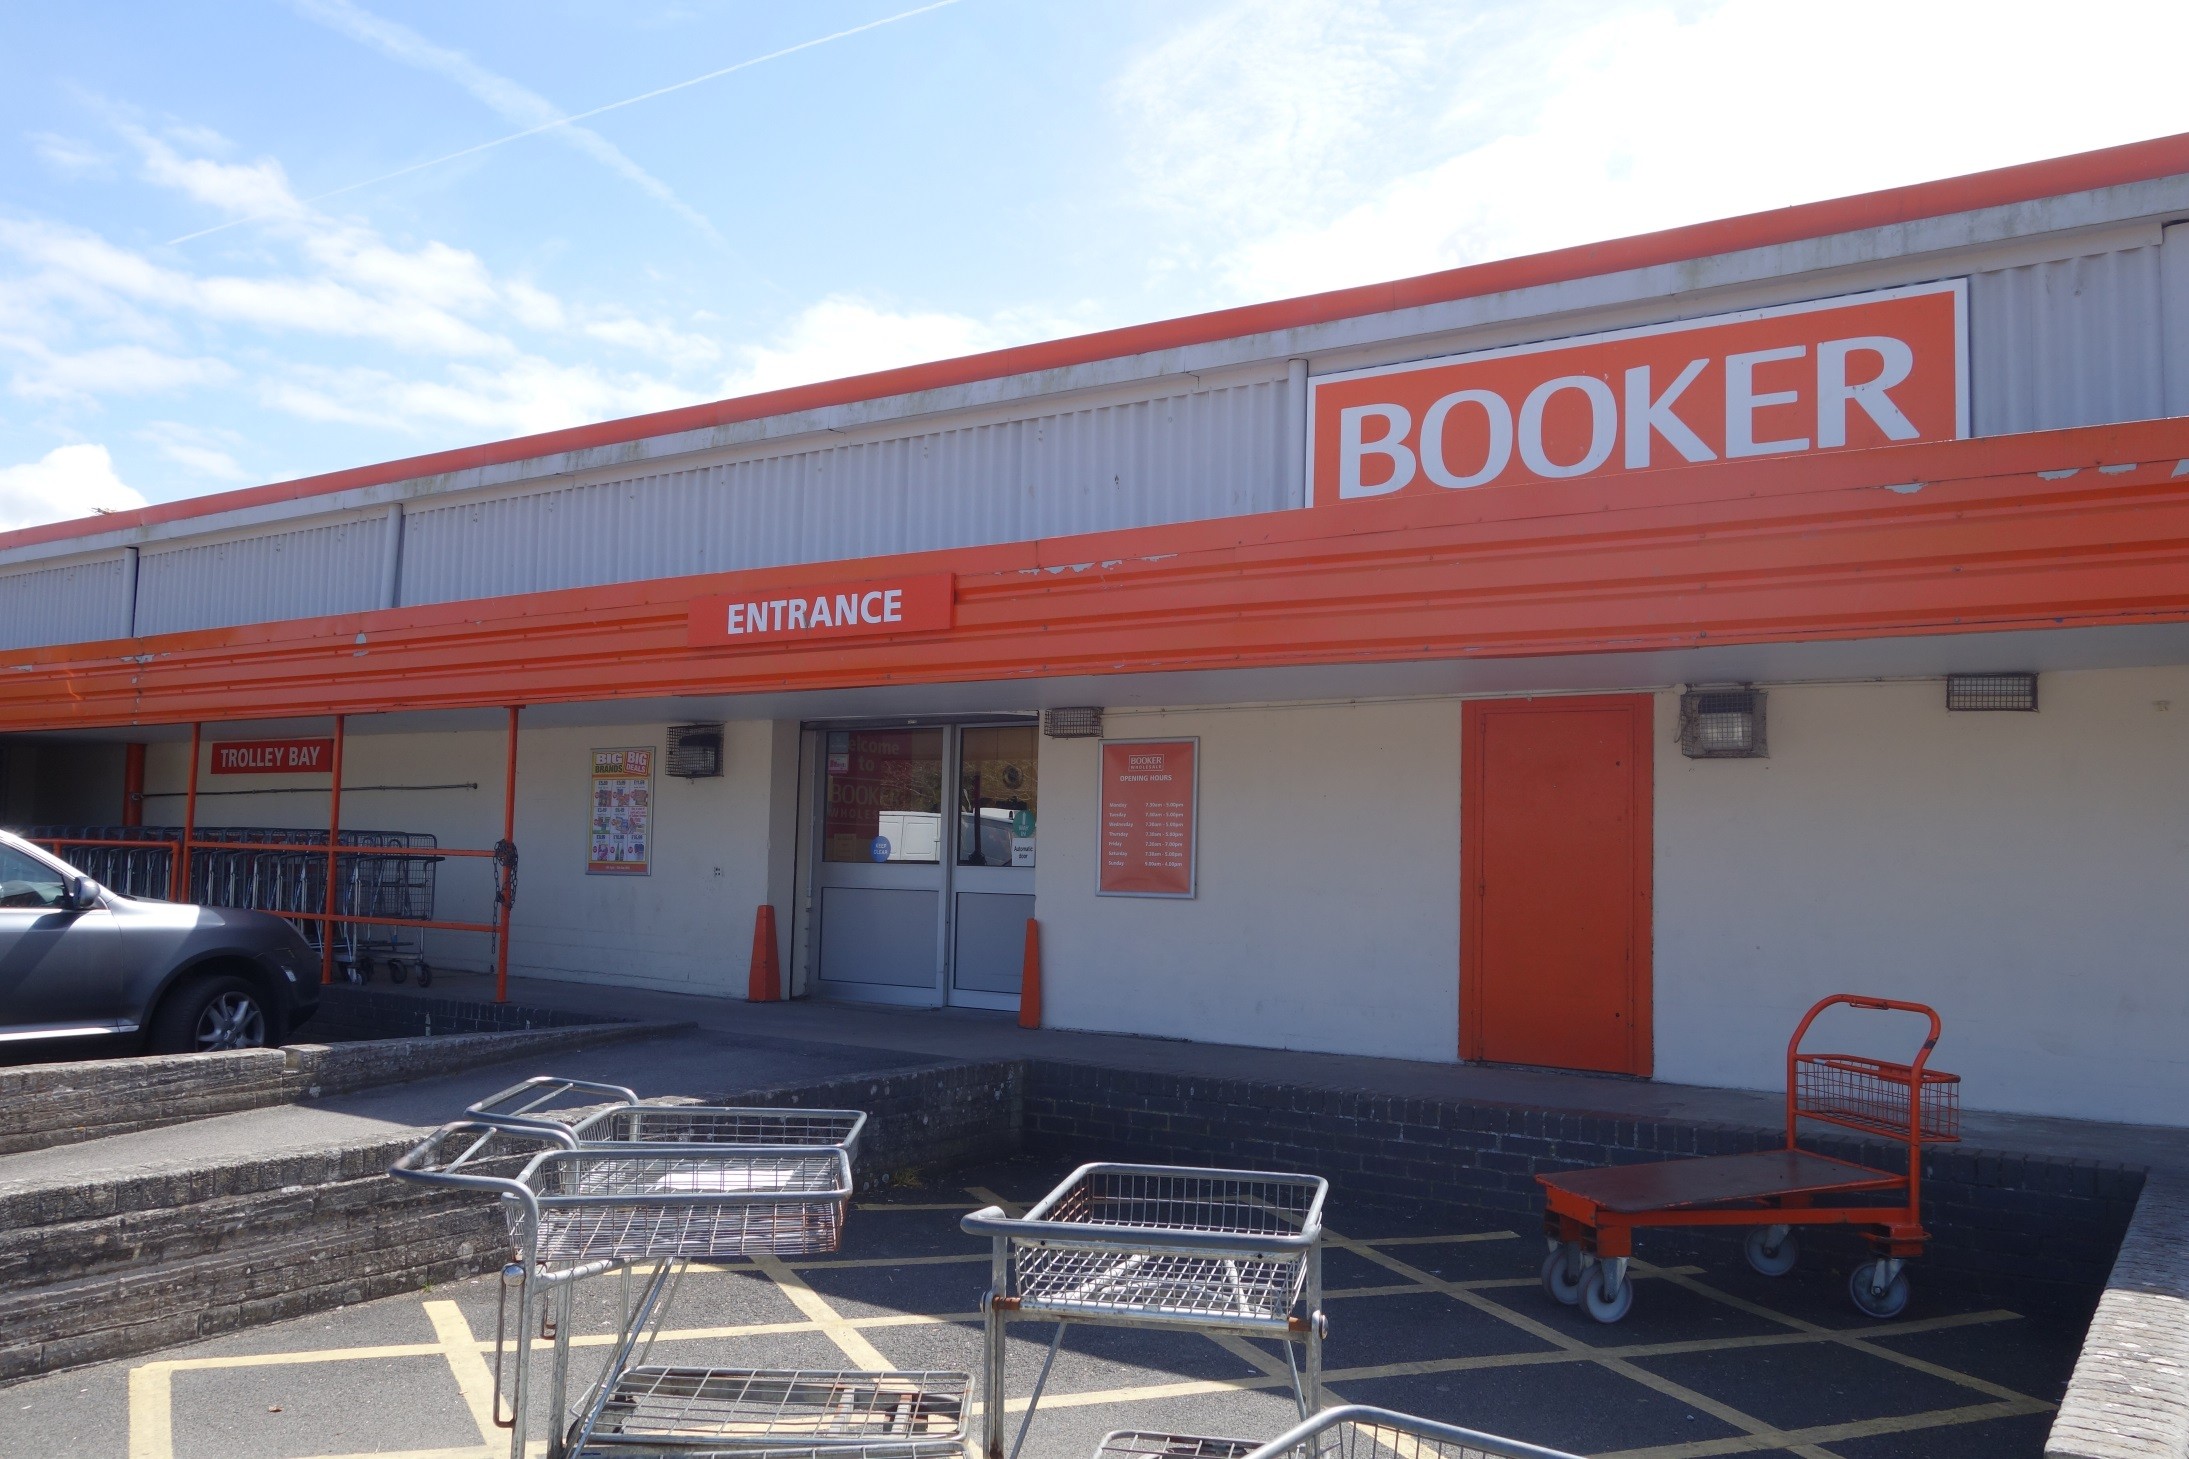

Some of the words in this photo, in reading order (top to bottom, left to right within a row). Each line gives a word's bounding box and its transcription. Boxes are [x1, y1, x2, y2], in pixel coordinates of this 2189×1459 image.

[1338, 335, 1920, 500] BOOKER
[727, 589, 903, 635] ENTRANCE
[849, 735, 900, 755] elcome
[221, 747, 284, 767] TROLLEY
[288, 746, 320, 766] BAY
[595, 753, 623, 765] BIG
[627, 751, 648, 766] BIG
[1130, 756, 1162, 765] BOOKER
[595, 764, 623, 773] BRANDS
[626, 763, 646, 773] DEALS
